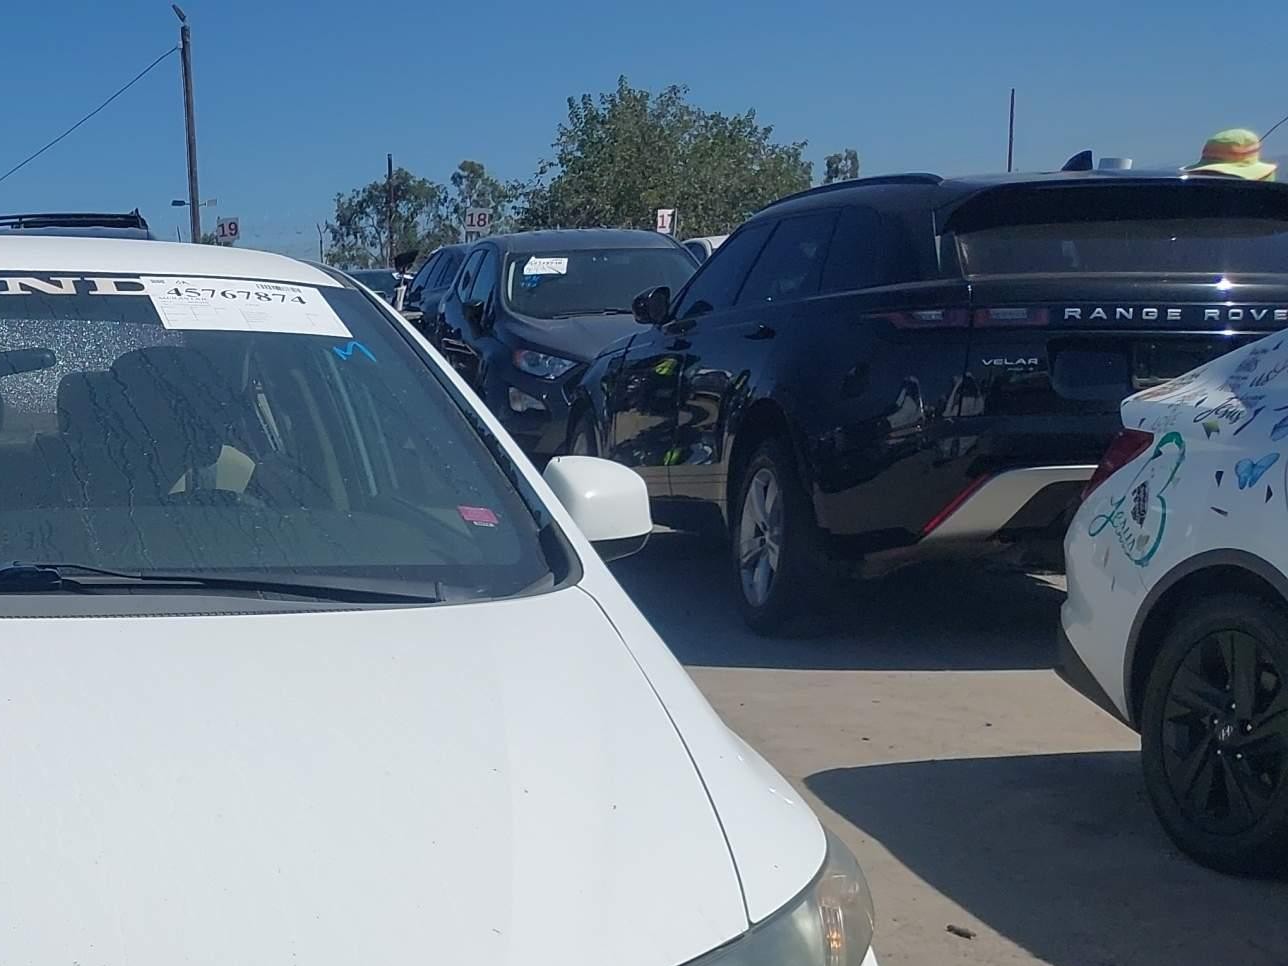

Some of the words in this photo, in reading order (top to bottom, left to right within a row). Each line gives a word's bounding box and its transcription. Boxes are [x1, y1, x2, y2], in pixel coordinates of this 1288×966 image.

[466, 212, 487, 228] 18
[217, 221, 239, 238] 19
[166, 287, 307, 306] 45767874
[1064, 307, 1181, 320] RANGE
[1204, 307, 1288, 320] ROVE
[982, 358, 1038, 366] VELAR
